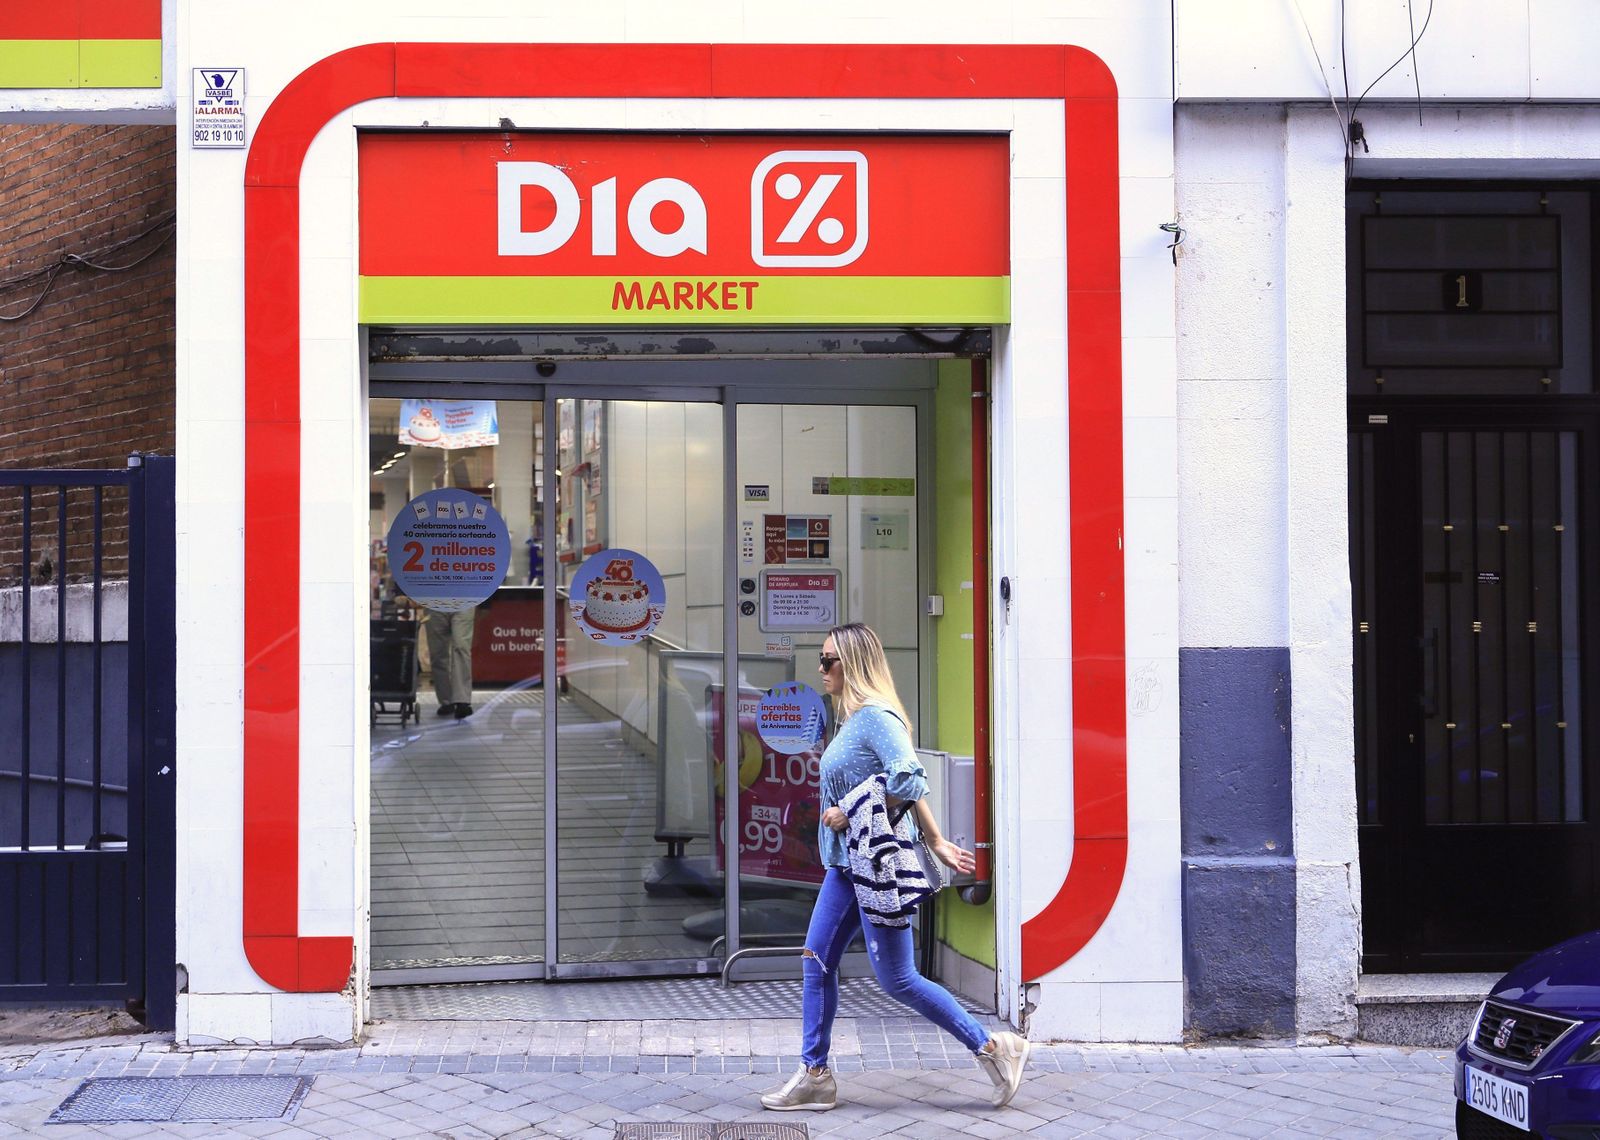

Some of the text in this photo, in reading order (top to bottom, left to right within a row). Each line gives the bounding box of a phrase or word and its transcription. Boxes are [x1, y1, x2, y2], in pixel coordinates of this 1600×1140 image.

[195, 130, 244, 141] 902 19 10 10
[612, 281, 759, 311] MARKET
[1456, 275, 1469, 307] 1
[413, 522, 457, 530] celebramos
[876, 528, 892, 536] L10
[403, 541, 496, 572] 2 millones
[430, 558, 496, 572] de euros
[605, 560, 633, 581] 40
[493, 626, 517, 637] Que
[491, 641, 538, 651] un buen
[761, 712, 802, 722] ofertas
[1471, 1073, 1526, 1123] 2505 KND
